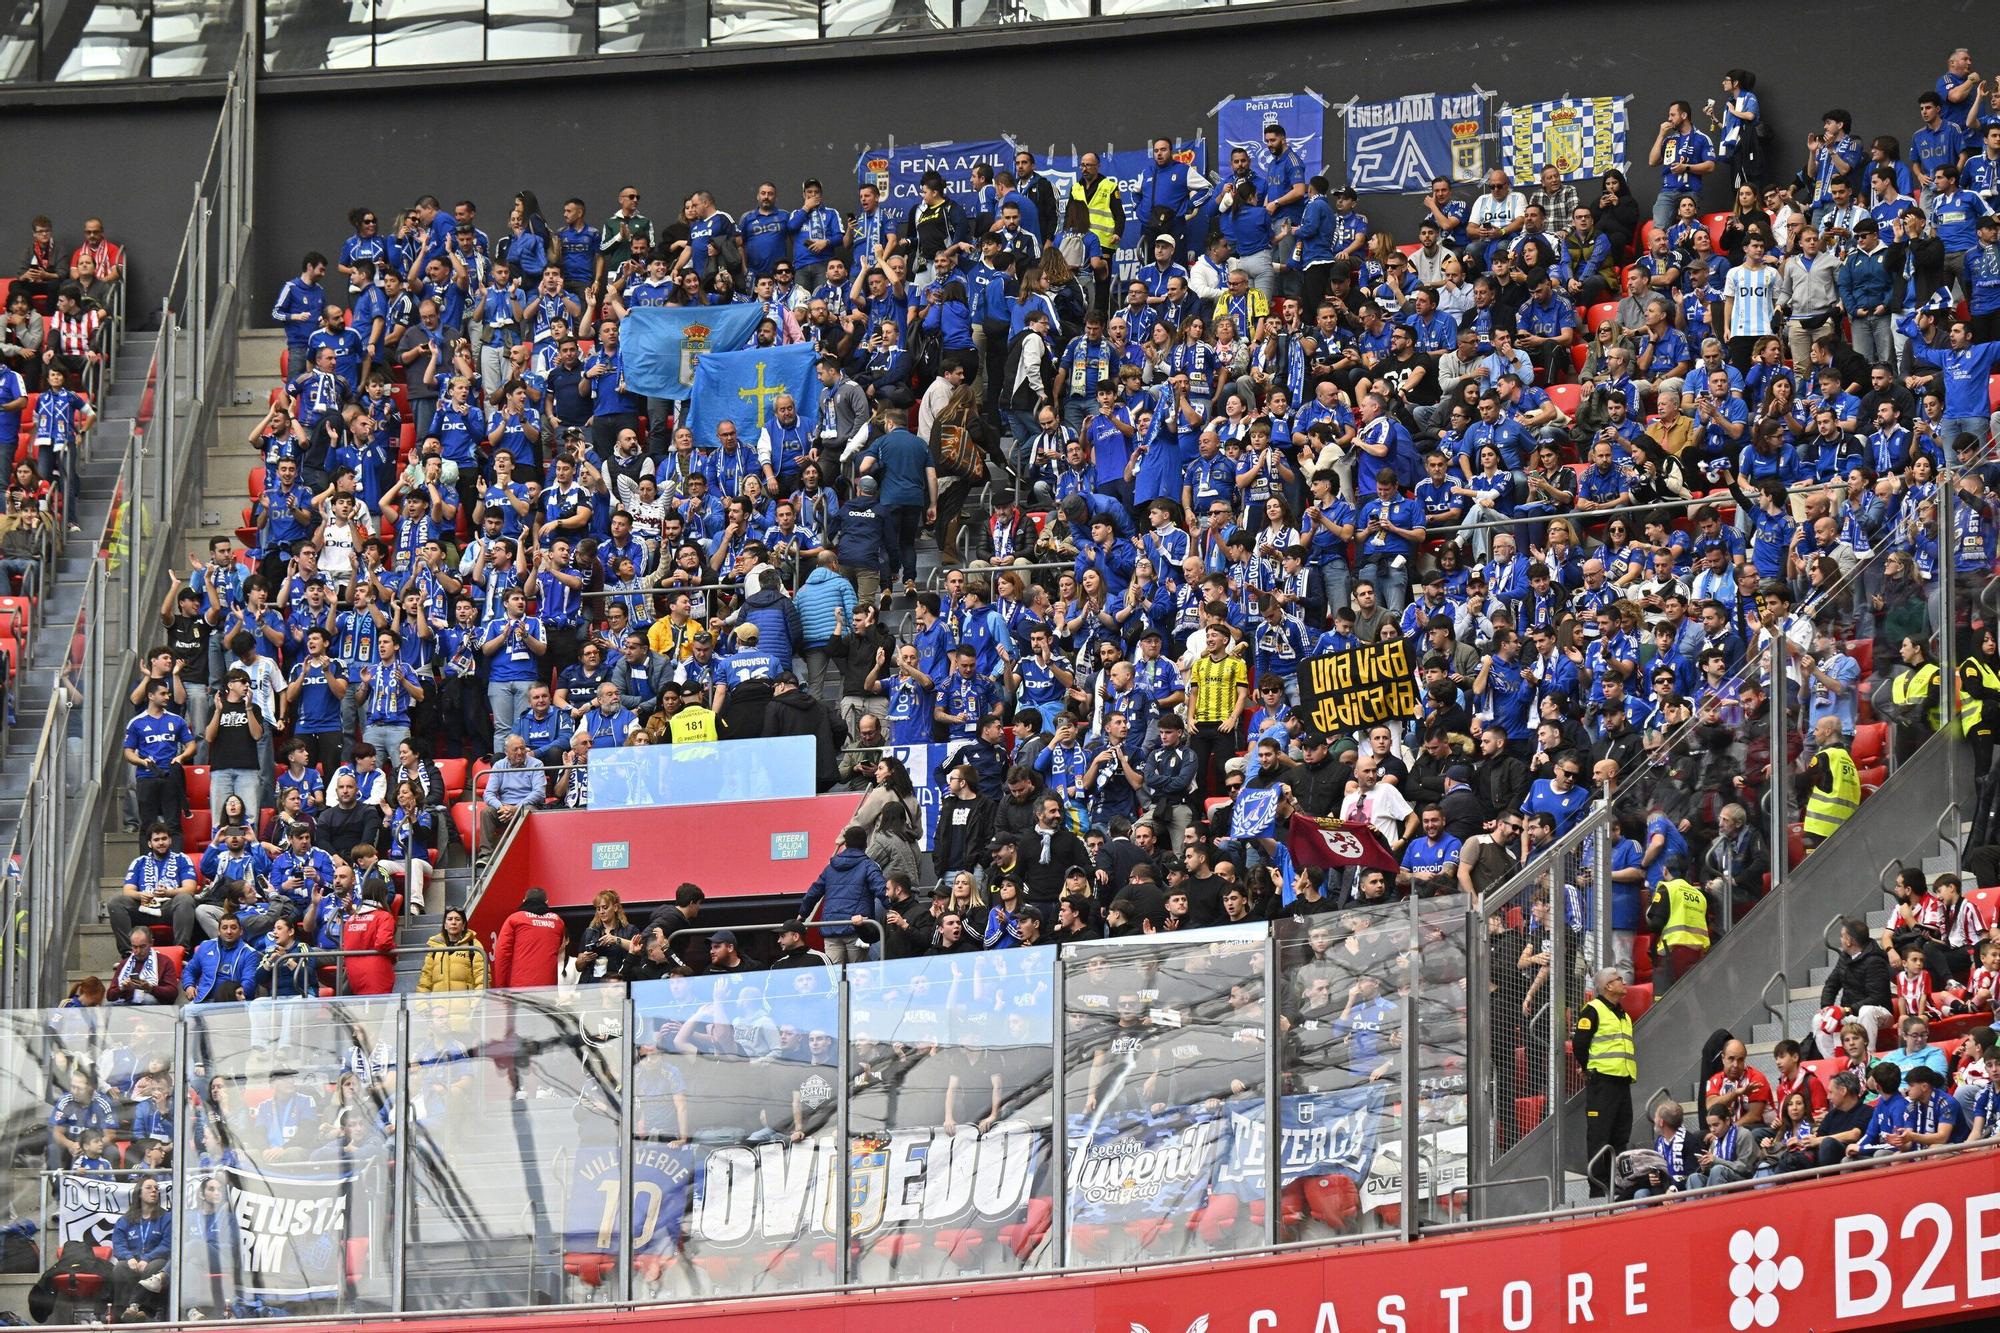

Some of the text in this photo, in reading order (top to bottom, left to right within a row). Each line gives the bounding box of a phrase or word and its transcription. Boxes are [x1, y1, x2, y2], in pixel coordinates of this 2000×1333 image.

[1246, 99, 1293, 111] Peña Azul
[1348, 95, 1481, 128] EMBAJADA AZUL
[1922, 146, 1947, 159] DIGI
[900, 153, 1004, 174] PEÑA AZUL
[1484, 211, 1511, 222] DIGI
[691, 229, 712, 239] DIGI
[752, 224, 781, 235] DIGI
[1740, 286, 1767, 298] DIGI
[641, 298, 664, 307] DIG
[1534, 323, 1555, 334] DIGI
[848, 510, 875, 519] adidas
[325, 540, 354, 548] DIGI
[731, 657, 770, 669] DUBOVSKY
[302, 677, 328, 685] DIGI
[1311, 680, 1415, 732] dedicada
[685, 720, 703, 731] 181
[145, 734, 175, 744] DIGI
[776, 834, 805, 843] IRTEERA
[597, 844, 626, 853] IRTEERA
[777, 842, 802, 850] SALIDA
[599, 852, 623, 860] SALIDA
[782, 850, 798, 858] EXIT
[602, 859, 619, 868] EXIT
[1683, 892, 1700, 904] 504
[1091, 1137, 1143, 1156] sección
[1067, 1123, 1212, 1190] Juvenil
[579, 1149, 689, 1184] VILLVERDE
[597, 1180, 662, 1250] 10
